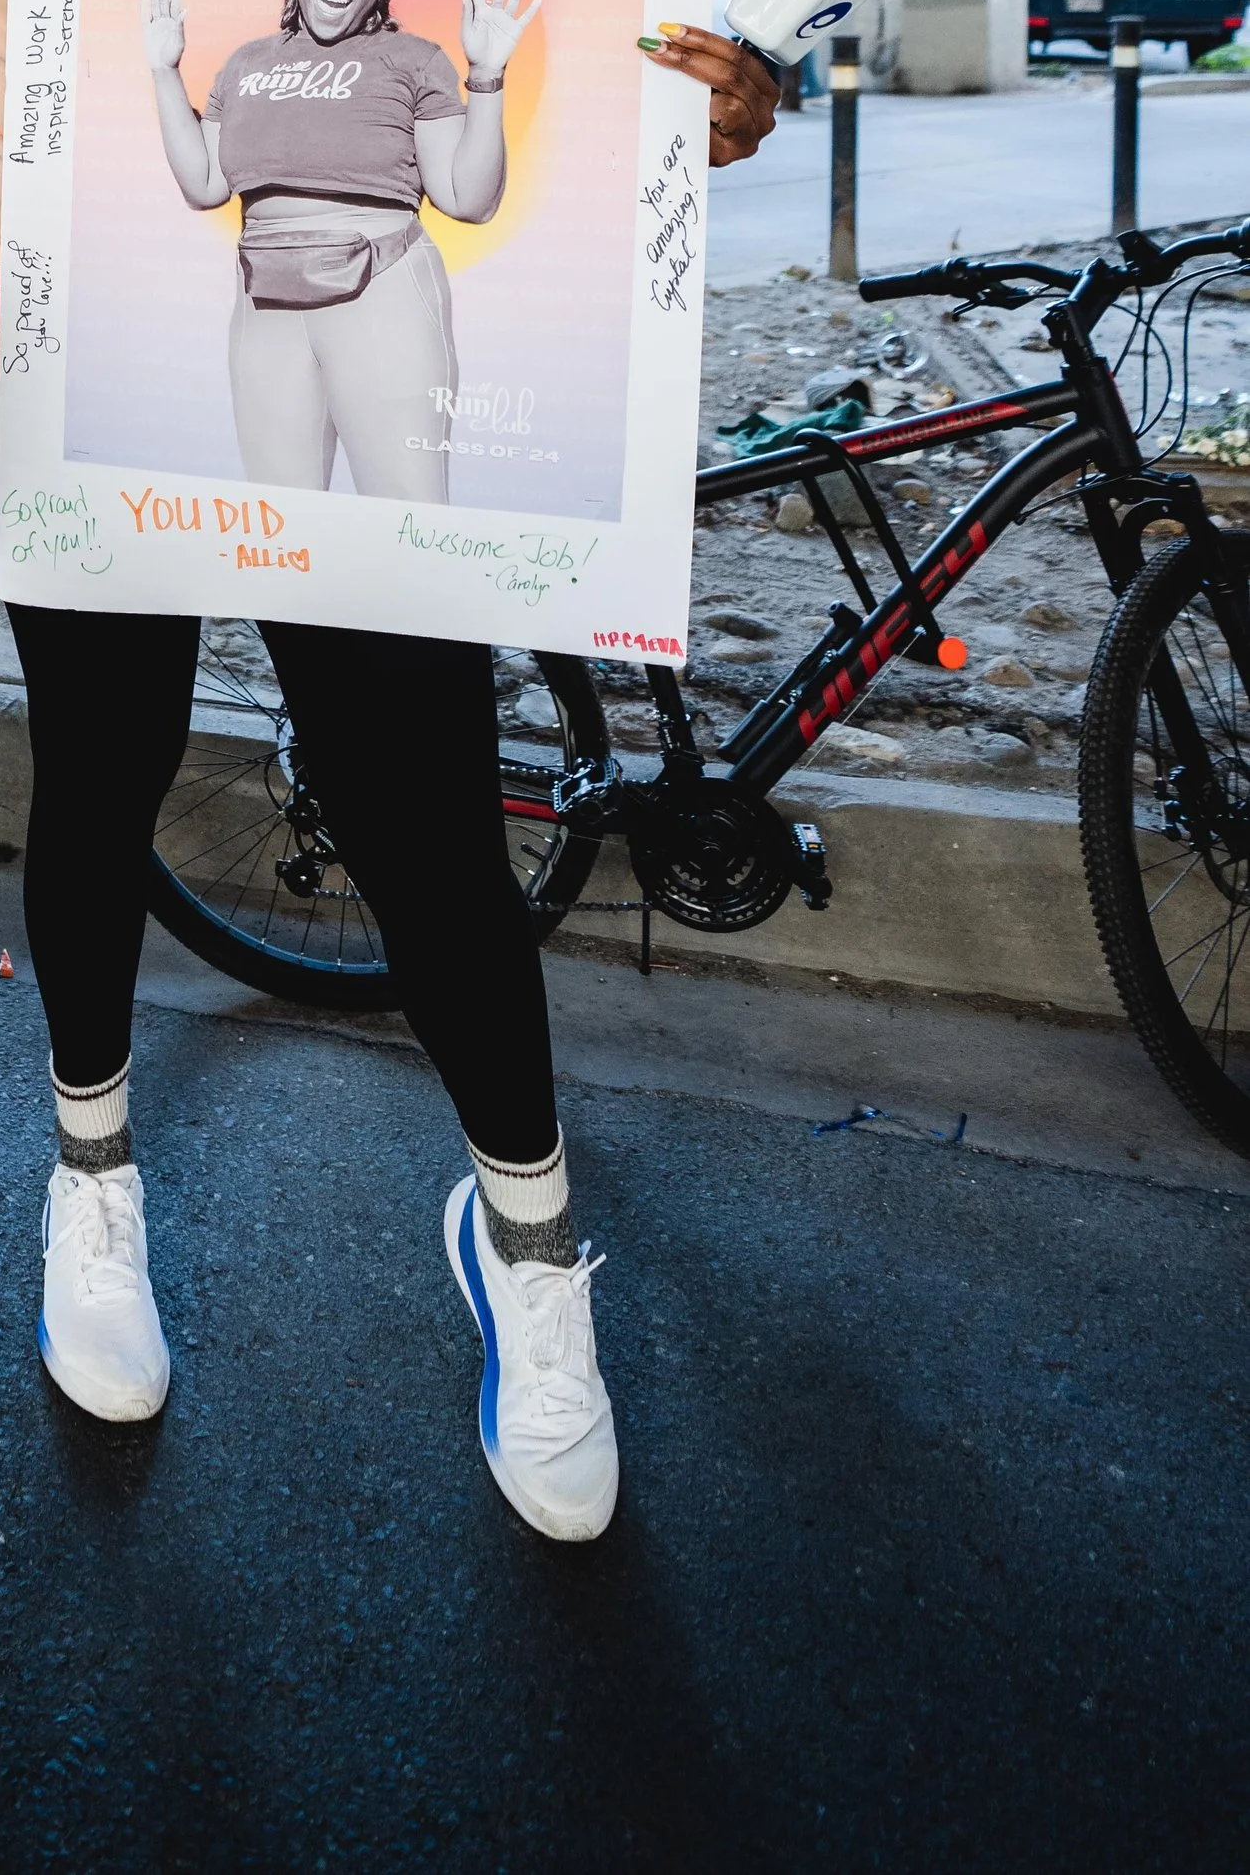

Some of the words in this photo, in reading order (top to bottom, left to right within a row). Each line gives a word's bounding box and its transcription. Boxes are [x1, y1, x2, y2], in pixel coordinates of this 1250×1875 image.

[239, 71, 303, 97] Run
[268, 60, 362, 101] Club
[9, 82, 51, 164] Amazing
[639, 178, 669, 219] You
[663, 134, 686, 171] are
[646, 166, 699, 264] amazing!
[428, 387, 490, 420] Run
[469, 386, 535, 435] Club
[405, 436, 486, 457] CLASS
[489, 444, 522, 459] OF
[526, 446, 561, 463] '24
[120, 487, 202, 533] YOU
[212, 498, 286, 539] DID
[398, 512, 512, 559] Awesome
[12, 530, 37, 563] of
[43, 517, 102, 571] you!!
